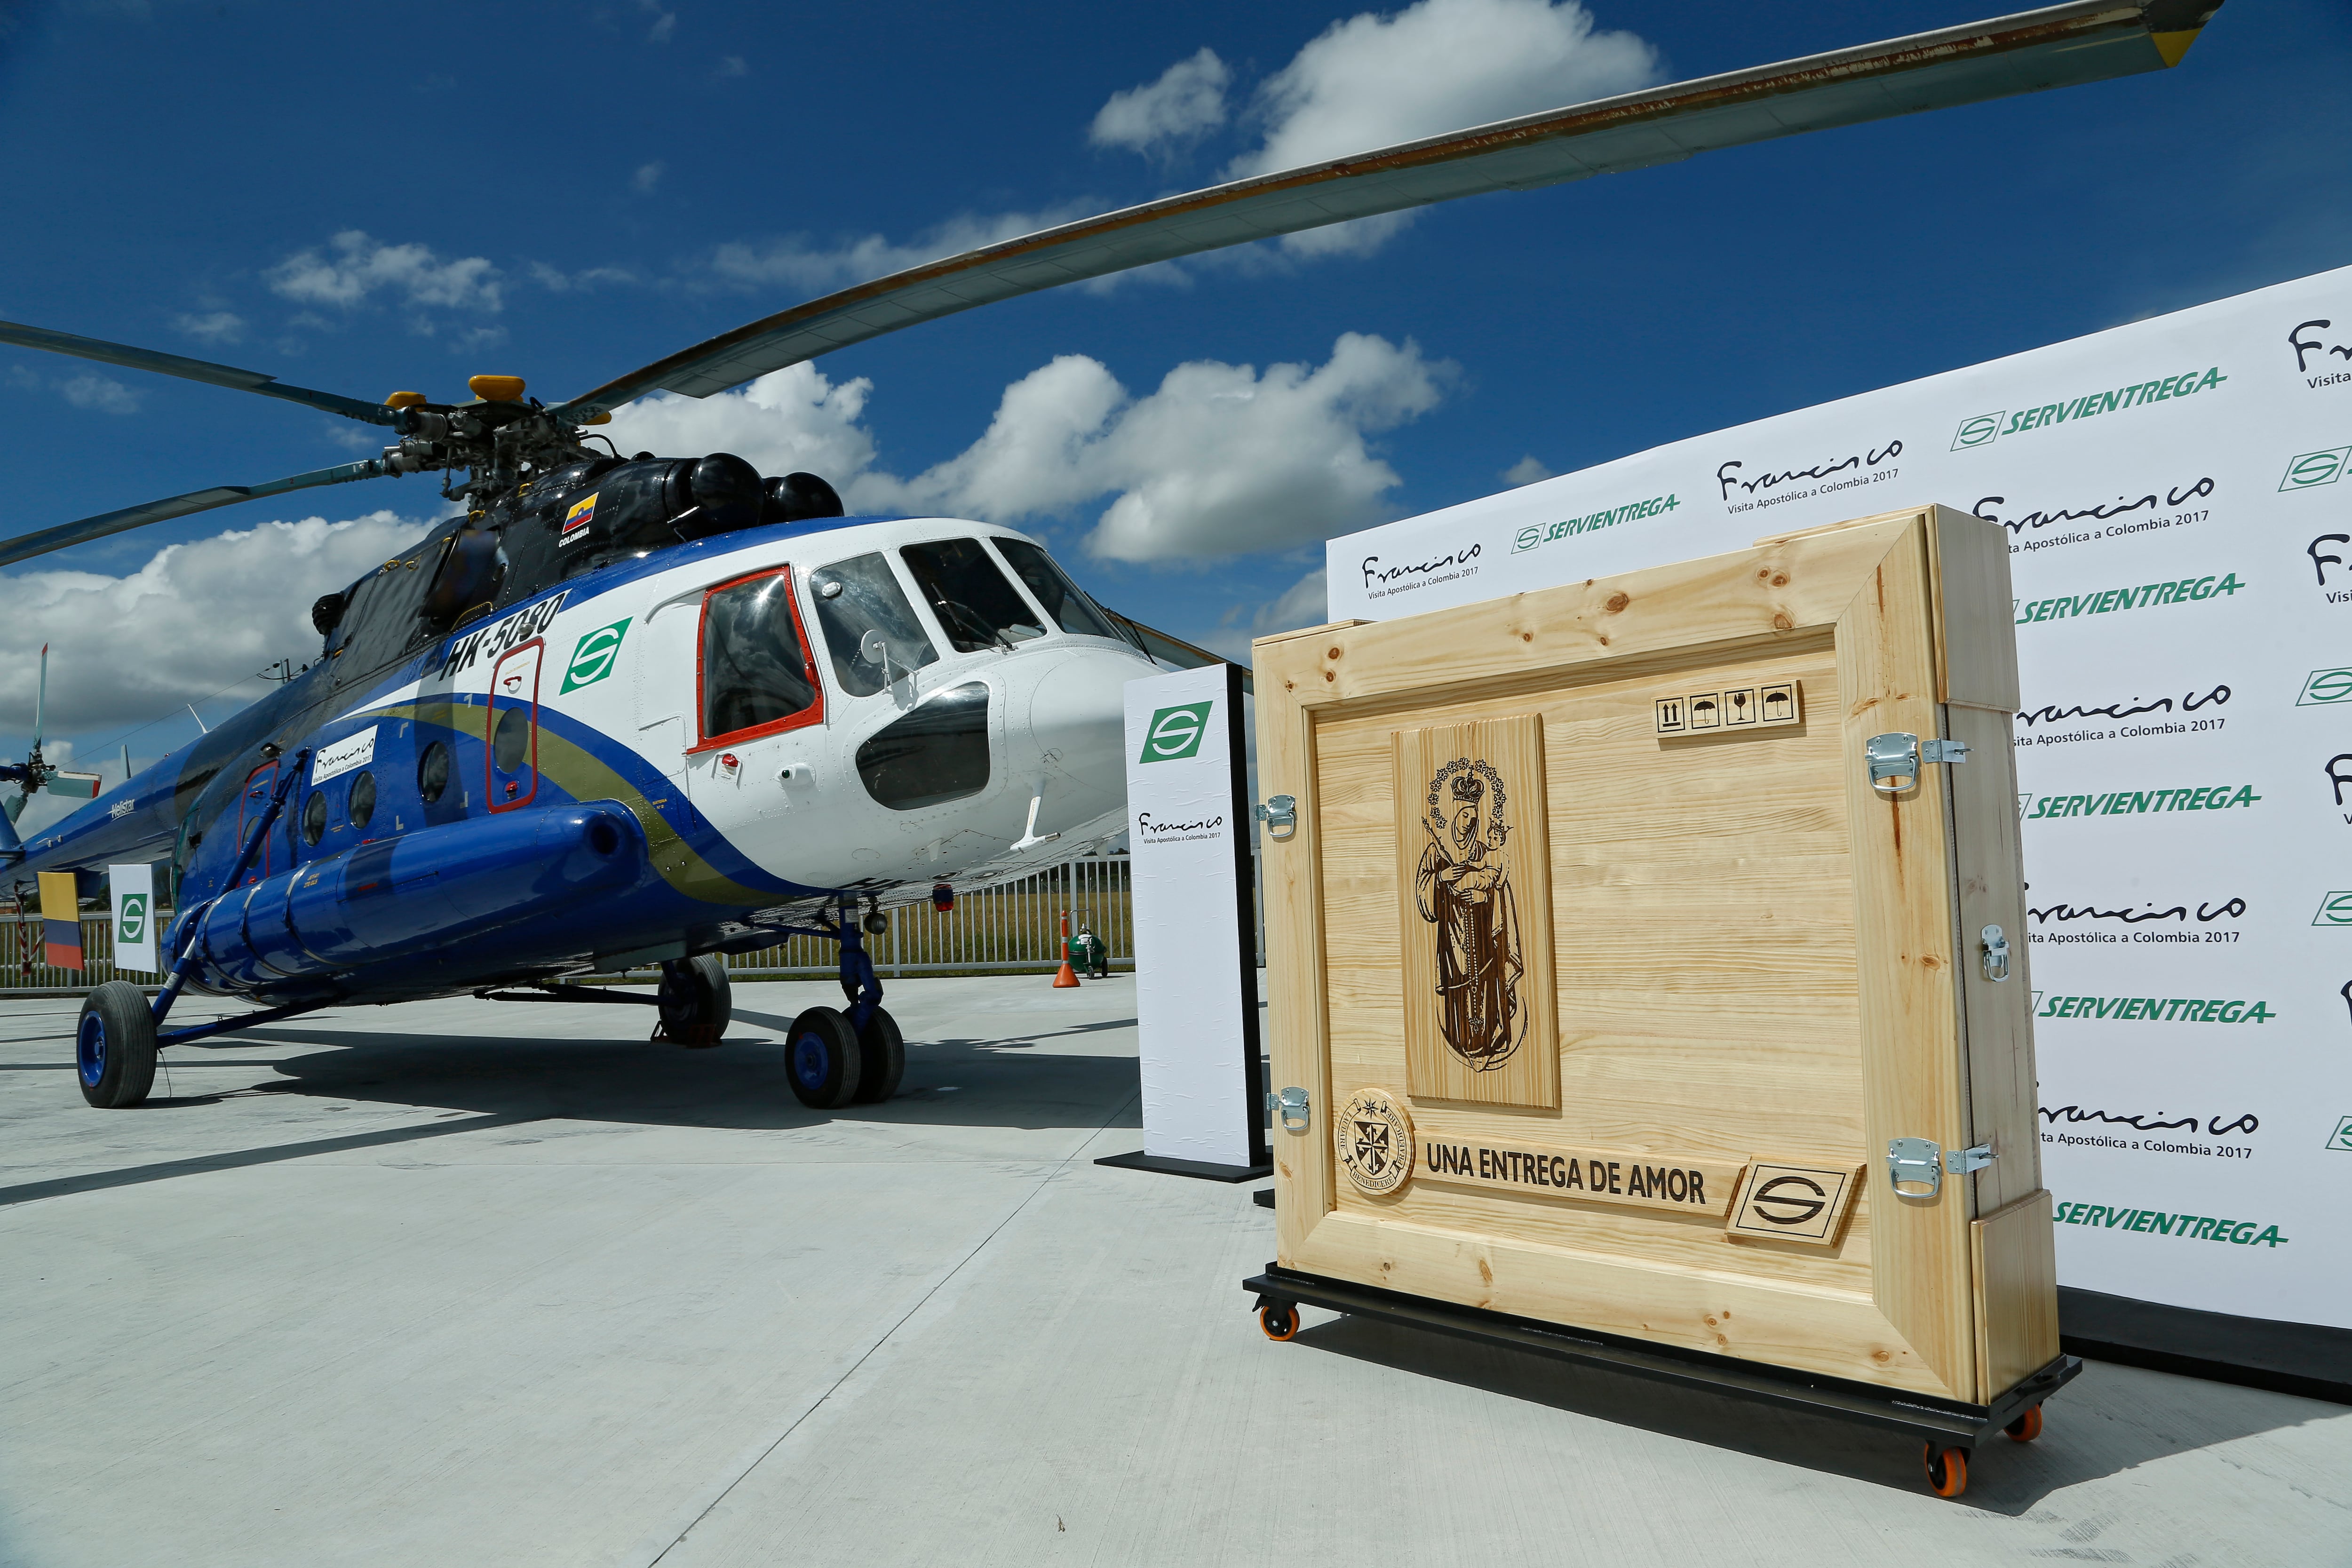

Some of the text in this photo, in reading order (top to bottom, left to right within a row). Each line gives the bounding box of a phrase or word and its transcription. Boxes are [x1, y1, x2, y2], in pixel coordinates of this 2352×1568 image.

[2307, 373, 2351, 389] Visita
[2002, 367, 2227, 435] SERVIENTREGA
[1717, 440, 1903, 501] Francisco
[1728, 503, 1754, 514] Visita
[1757, 491, 1807, 509] Apostólica
[1820, 478, 1869, 493] Colombia
[1873, 469, 1898, 482] 2017
[1543, 494, 1680, 542] SERVIENTREGA
[2024, 533, 2090, 552] Apostólica
[2106, 518, 2170, 536] Colombia
[2176, 510, 2209, 526] 2017
[558, 526, 589, 548] COLOMBIA
[1362, 543, 1481, 589] Francisco
[1368, 590, 1385, 599] Visita
[1387, 583, 1420, 596] Apostólica
[1428, 573, 1459, 585] Colombia
[1462, 566, 1478, 577] 2017
[2016, 573, 2245, 624] SERVIENTREGA
[2016, 685, 2231, 727] rancisco
[2036, 730, 2104, 747] Apostólica
[2121, 720, 2185, 737] Colombia
[2191, 718, 2225, 732] 2017
[316, 738, 373, 774] Francisco
[323, 768, 342, 779] Apostólica
[345, 759, 362, 770] Colombia
[107, 798, 135, 819] Helistar
[2028, 785, 2261, 819] SERVIENTREGA
[1138, 812, 1222, 836] Francisco
[2028, 898, 2246, 924] rancisco
[2048, 932, 2116, 945] Apostólica
[2133, 931, 2200, 943] Colombia
[2205, 931, 2240, 943] 2017
[2039, 996, 2276, 1023] SERVIENTREGA
[1340, 1111, 1353, 1150] LAUDARE
[1386, 1110, 1406, 1166] PRAEDICARE
[2039, 1106, 2259, 1136] rancisco
[2058, 1133, 2127, 1148] Apostólica
[2131, 1141, 2139, 1150] a
[2144, 1140, 2211, 1155] Colombia
[2217, 1146, 2252, 1159] 2017
[1352, 1172, 1394, 1187] BENEDICERE
[1427, 1143, 1707, 1204] UNA ENTREGA DE AMOR
[2053, 1202, 2289, 1247] SERVIENTREGA
